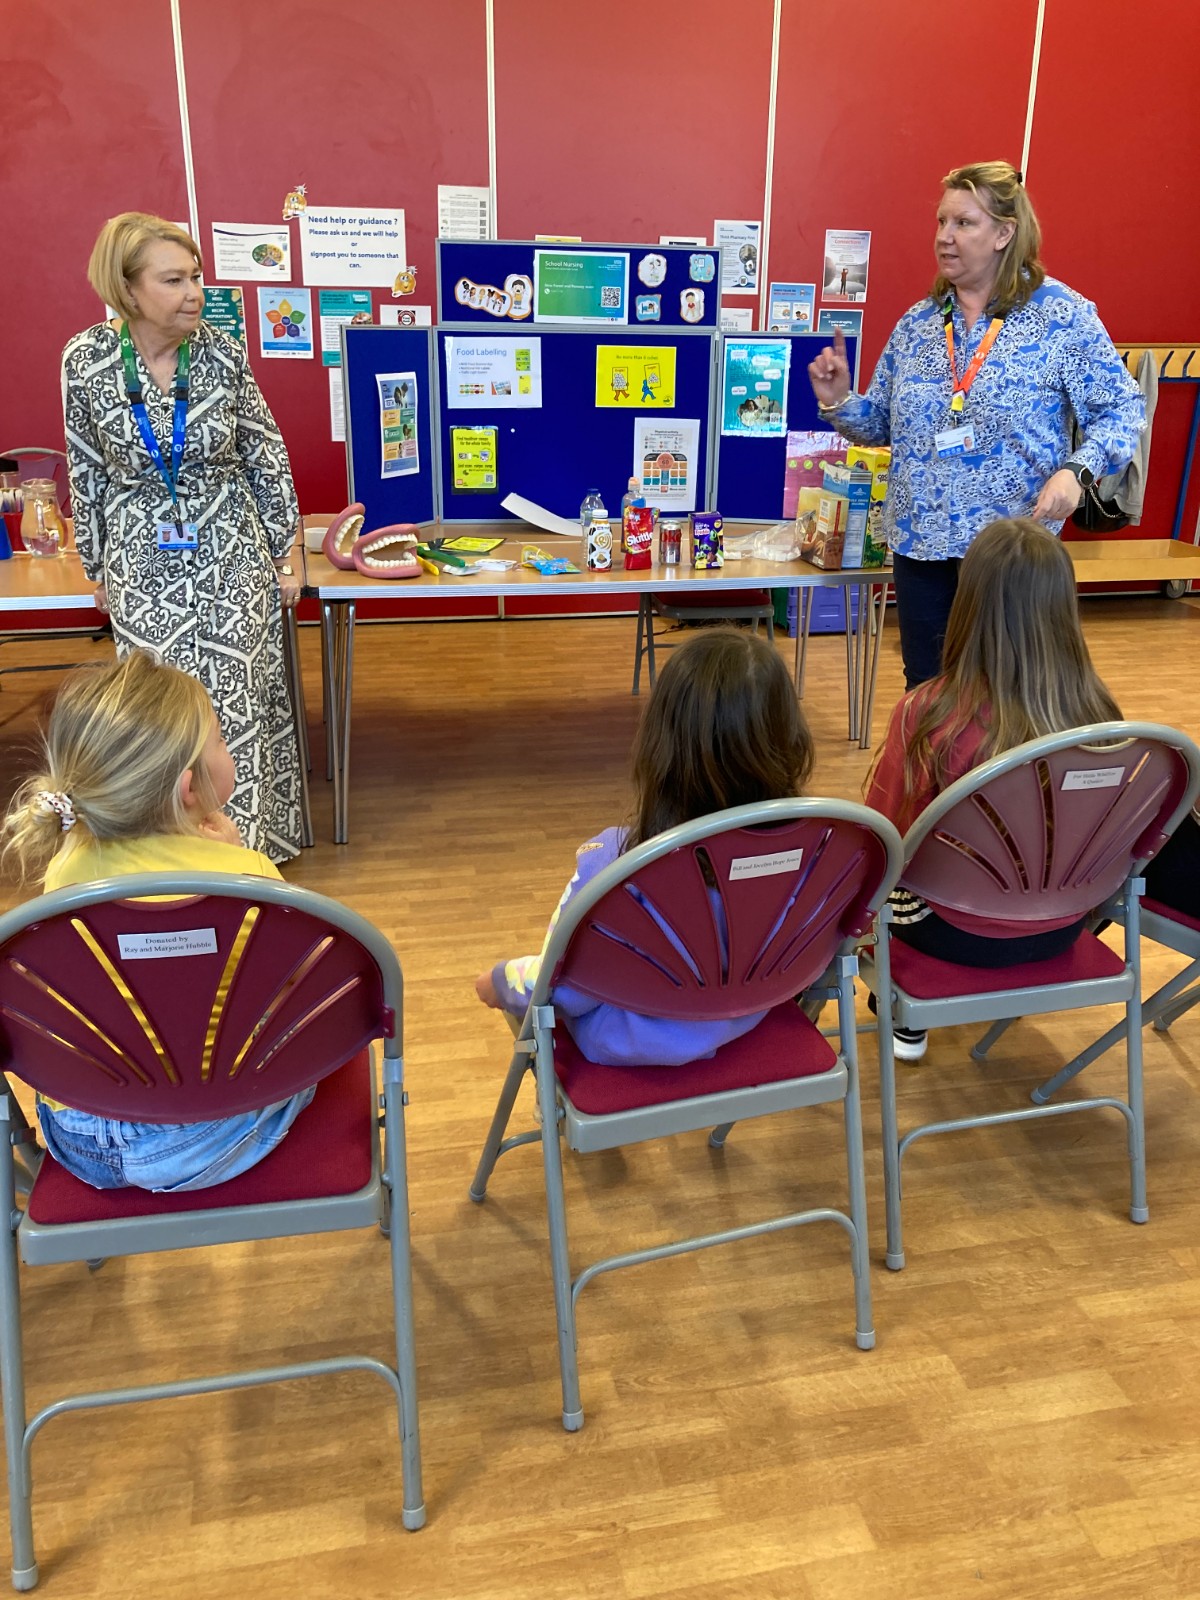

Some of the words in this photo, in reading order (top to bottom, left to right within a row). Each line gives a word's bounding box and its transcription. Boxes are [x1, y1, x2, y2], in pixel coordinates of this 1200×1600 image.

[330, 216, 346, 225] help
[358, 217, 392, 226] guidance
[310, 251, 336, 259] signpost
[563, 261, 584, 269] Nursing
[456, 348, 475, 356] Food
[476, 348, 507, 357] Labelling
[145, 936, 177, 945] Donated
[154, 945, 185, 953] Marjorie
[186, 942, 212, 950] Hubble
